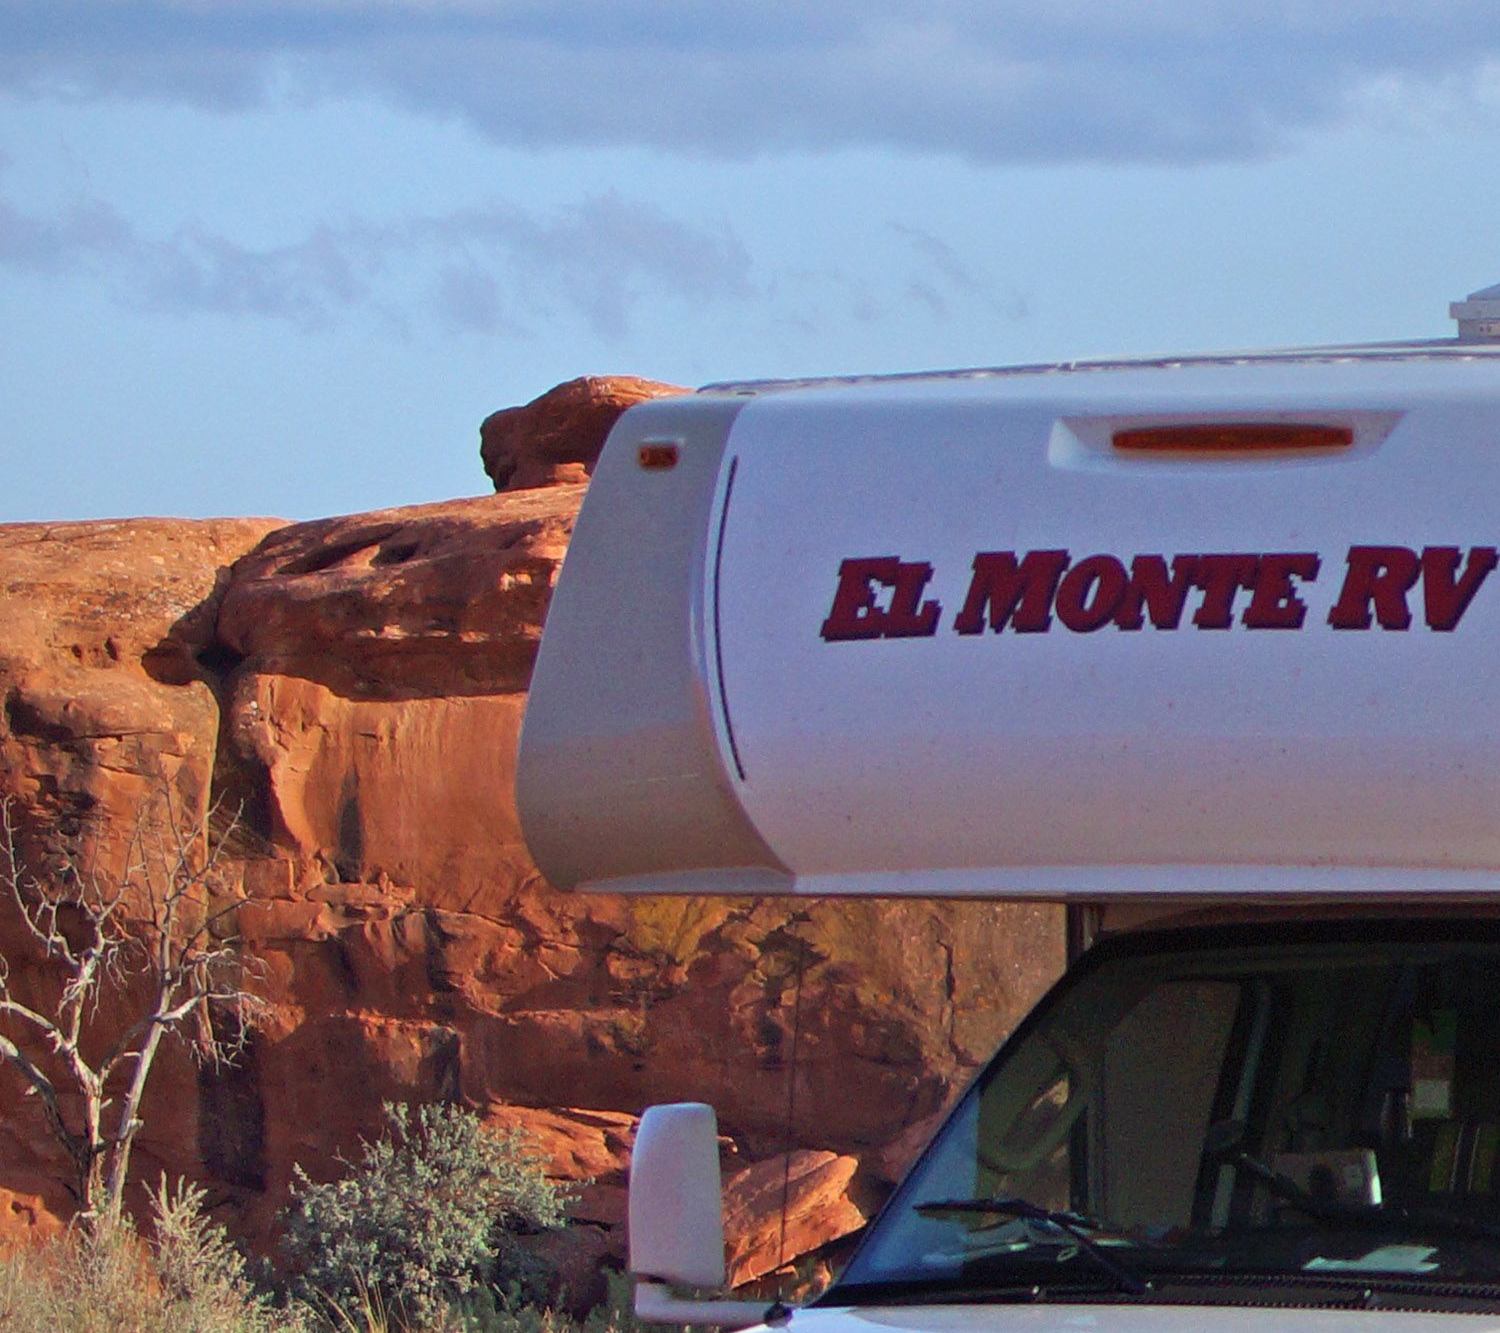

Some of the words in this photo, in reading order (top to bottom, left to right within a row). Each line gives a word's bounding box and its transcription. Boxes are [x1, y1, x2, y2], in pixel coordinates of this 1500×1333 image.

[820, 556, 943, 642] EL
[953, 549, 1323, 635] MONTE
[1327, 546, 1500, 631] RV
